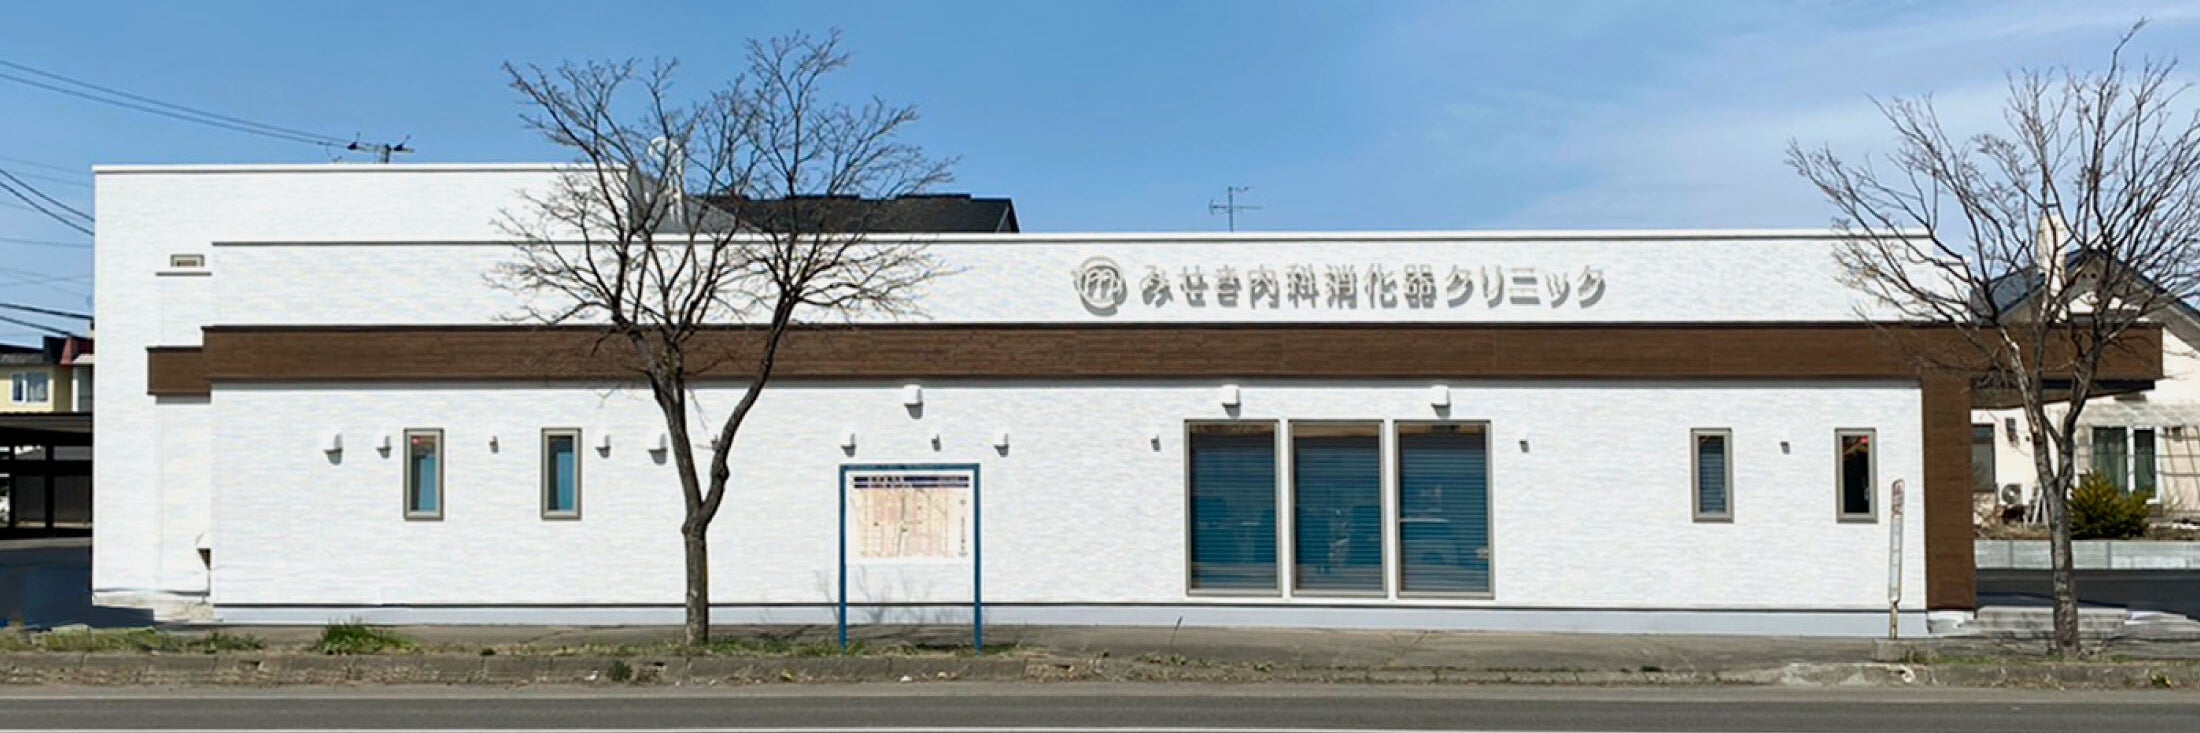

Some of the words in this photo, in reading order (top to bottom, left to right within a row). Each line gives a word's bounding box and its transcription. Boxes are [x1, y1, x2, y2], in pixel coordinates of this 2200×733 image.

[1139, 264, 1605, 308] みせき内科消化器クリニック
